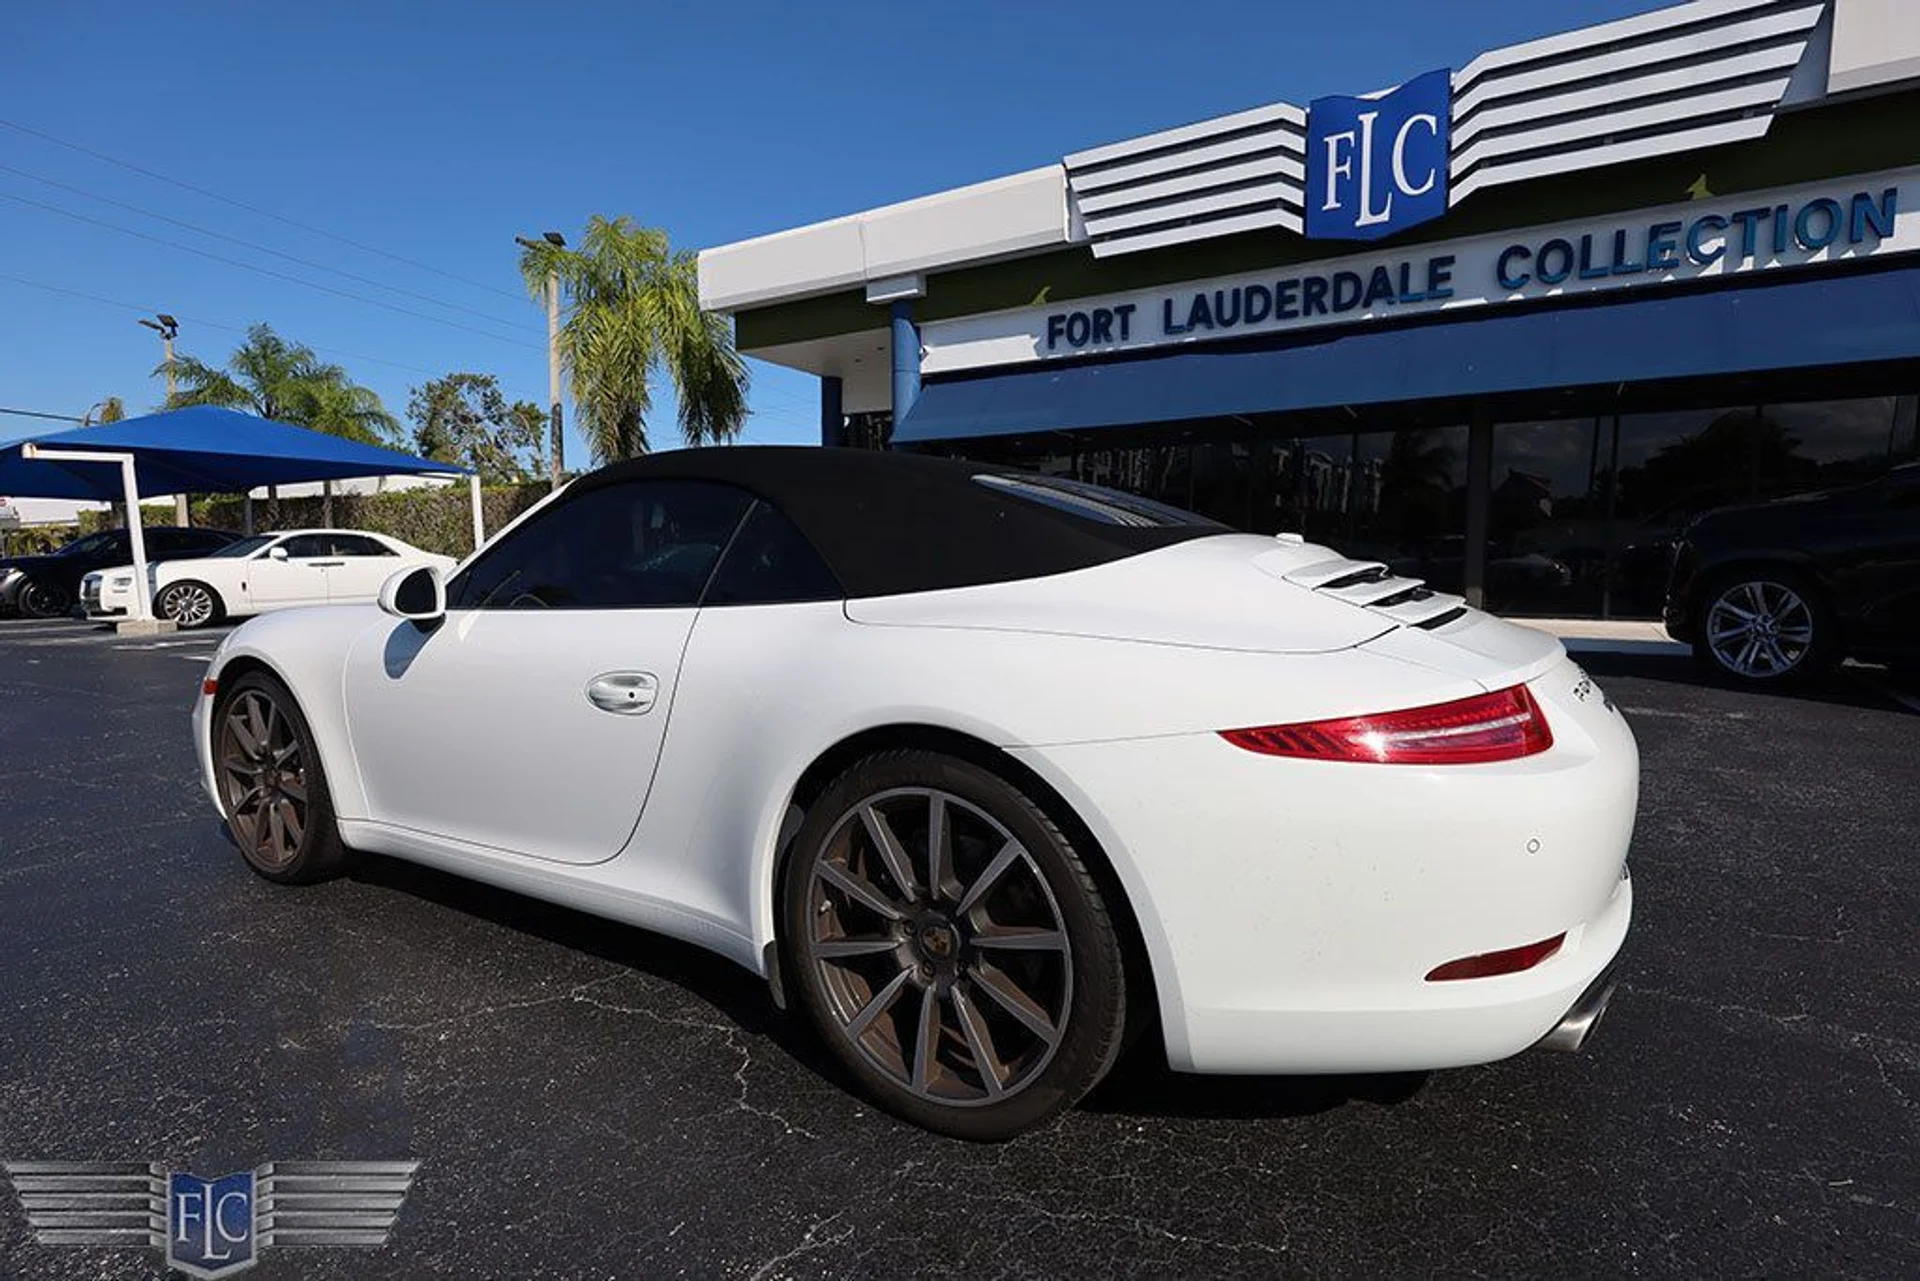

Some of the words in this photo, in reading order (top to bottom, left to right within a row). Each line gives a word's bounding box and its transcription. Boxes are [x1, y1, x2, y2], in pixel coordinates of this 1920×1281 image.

[1321, 111, 1437, 227] FLC
[1047, 303, 1136, 350] FORT
[1163, 255, 1456, 336] LAUDERDALE
[1496, 187, 1898, 290] COLLECTION
